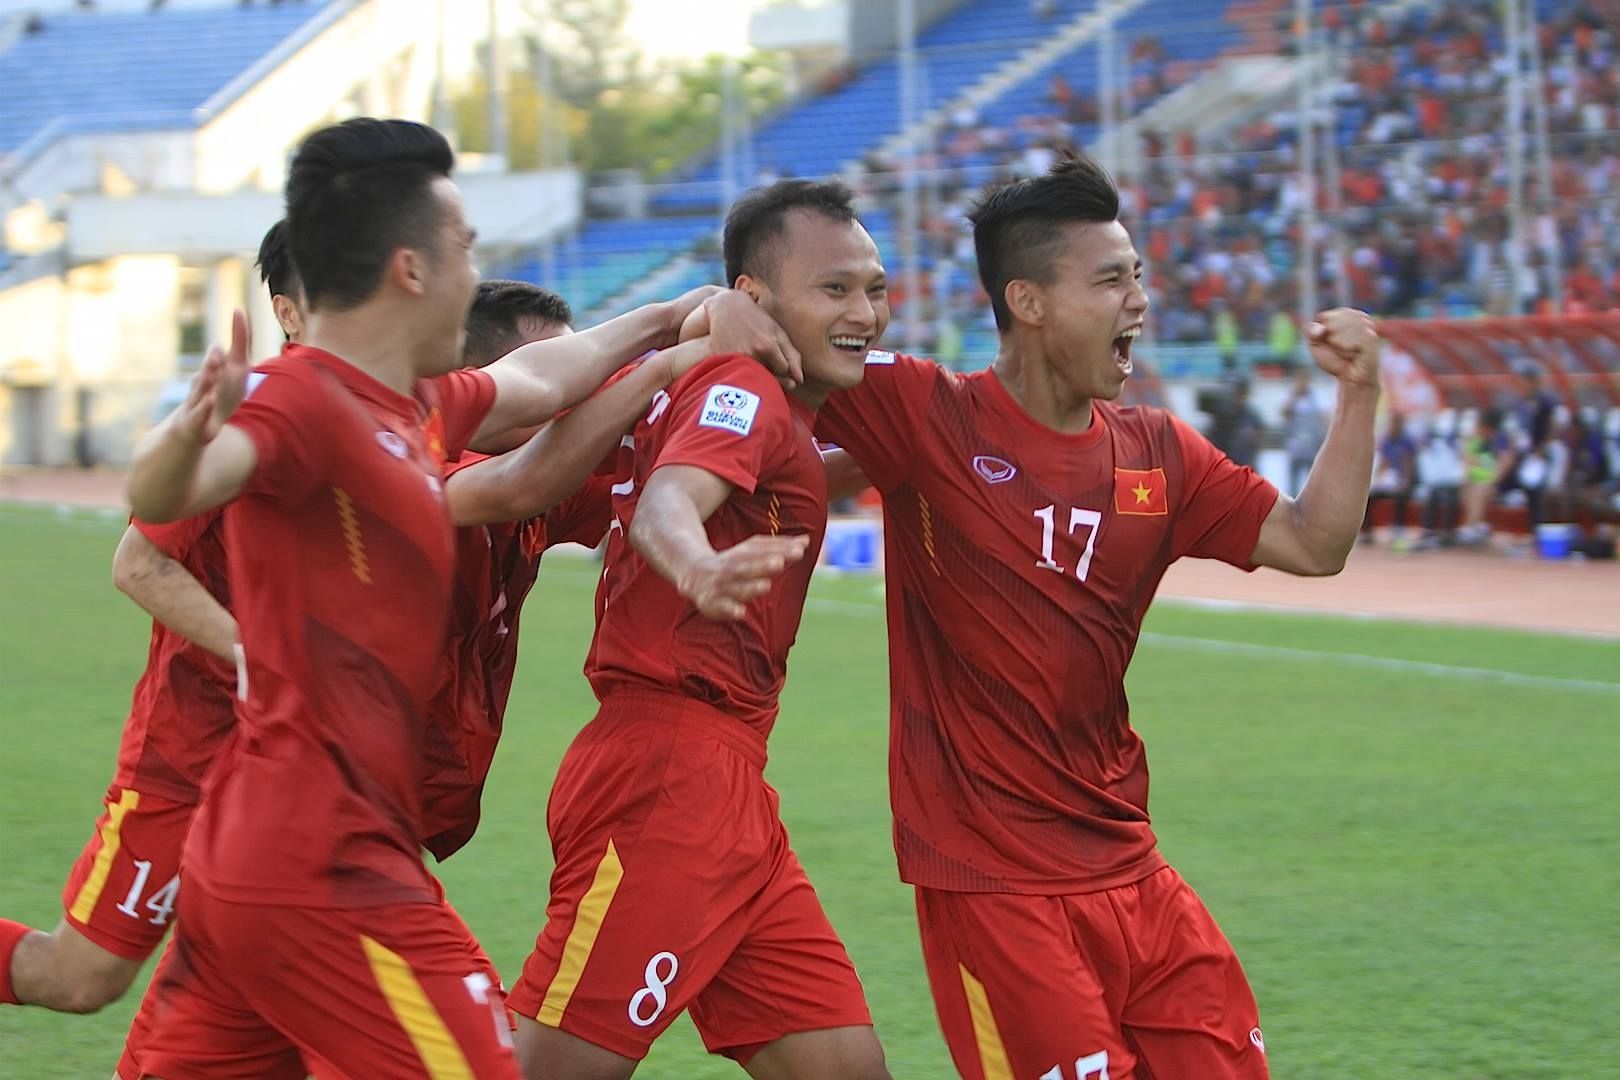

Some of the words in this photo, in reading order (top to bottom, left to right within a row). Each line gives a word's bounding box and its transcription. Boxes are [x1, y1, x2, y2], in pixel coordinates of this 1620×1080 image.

[708, 411, 749, 425] SUZUKI
[1033, 504, 1102, 582] 17
[116, 860, 181, 924] 14
[628, 951, 679, 1027] 8
